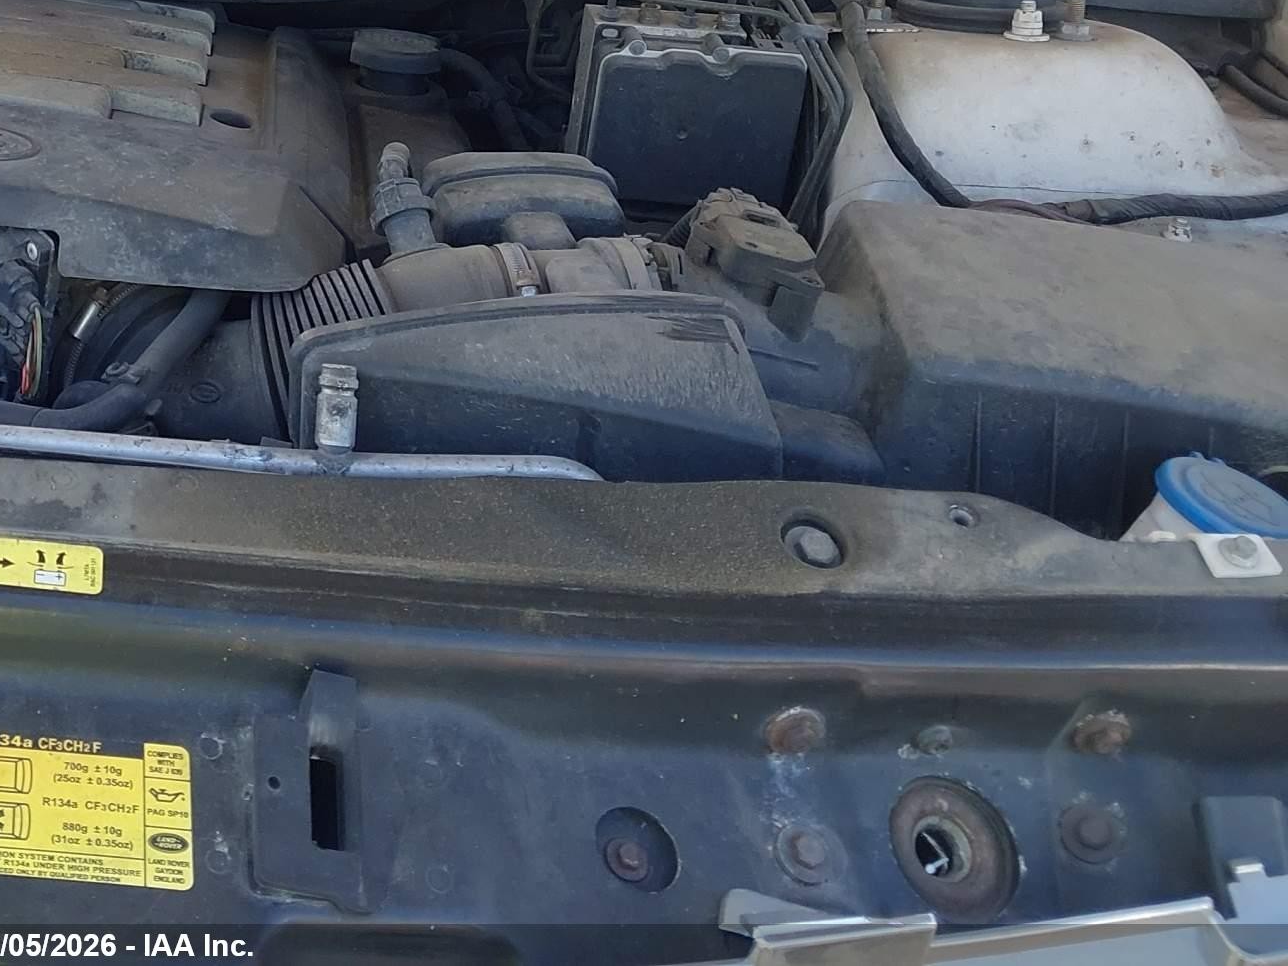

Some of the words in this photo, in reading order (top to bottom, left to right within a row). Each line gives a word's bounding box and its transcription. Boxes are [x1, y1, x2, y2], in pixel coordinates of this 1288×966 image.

[147, 750, 184, 760] COMPLIES
[64, 762, 89, 772] 700g
[53, 773, 81, 784] (25oz
[42, 796, 78, 808] R134a
[147, 808, 165, 816] PAG
[62, 822, 88, 834] 880g
[52, 834, 81, 845] (31oz
[18, 852, 55, 862] SYSTEM
[57, 856, 104, 866] CONTAINS
[168, 860, 190, 868] ROVER
[16, 868, 35, 876] ONLY
[50, 871, 89, 880] QUALIFIED
[90, 874, 121, 882] PERSON
[33, 862, 65, 870] UNDER
[67, 864, 90, 872] HIGH
[92, 866, 142, 877] PRESSURE
[154, 876, 185, 884] ENGLAND
